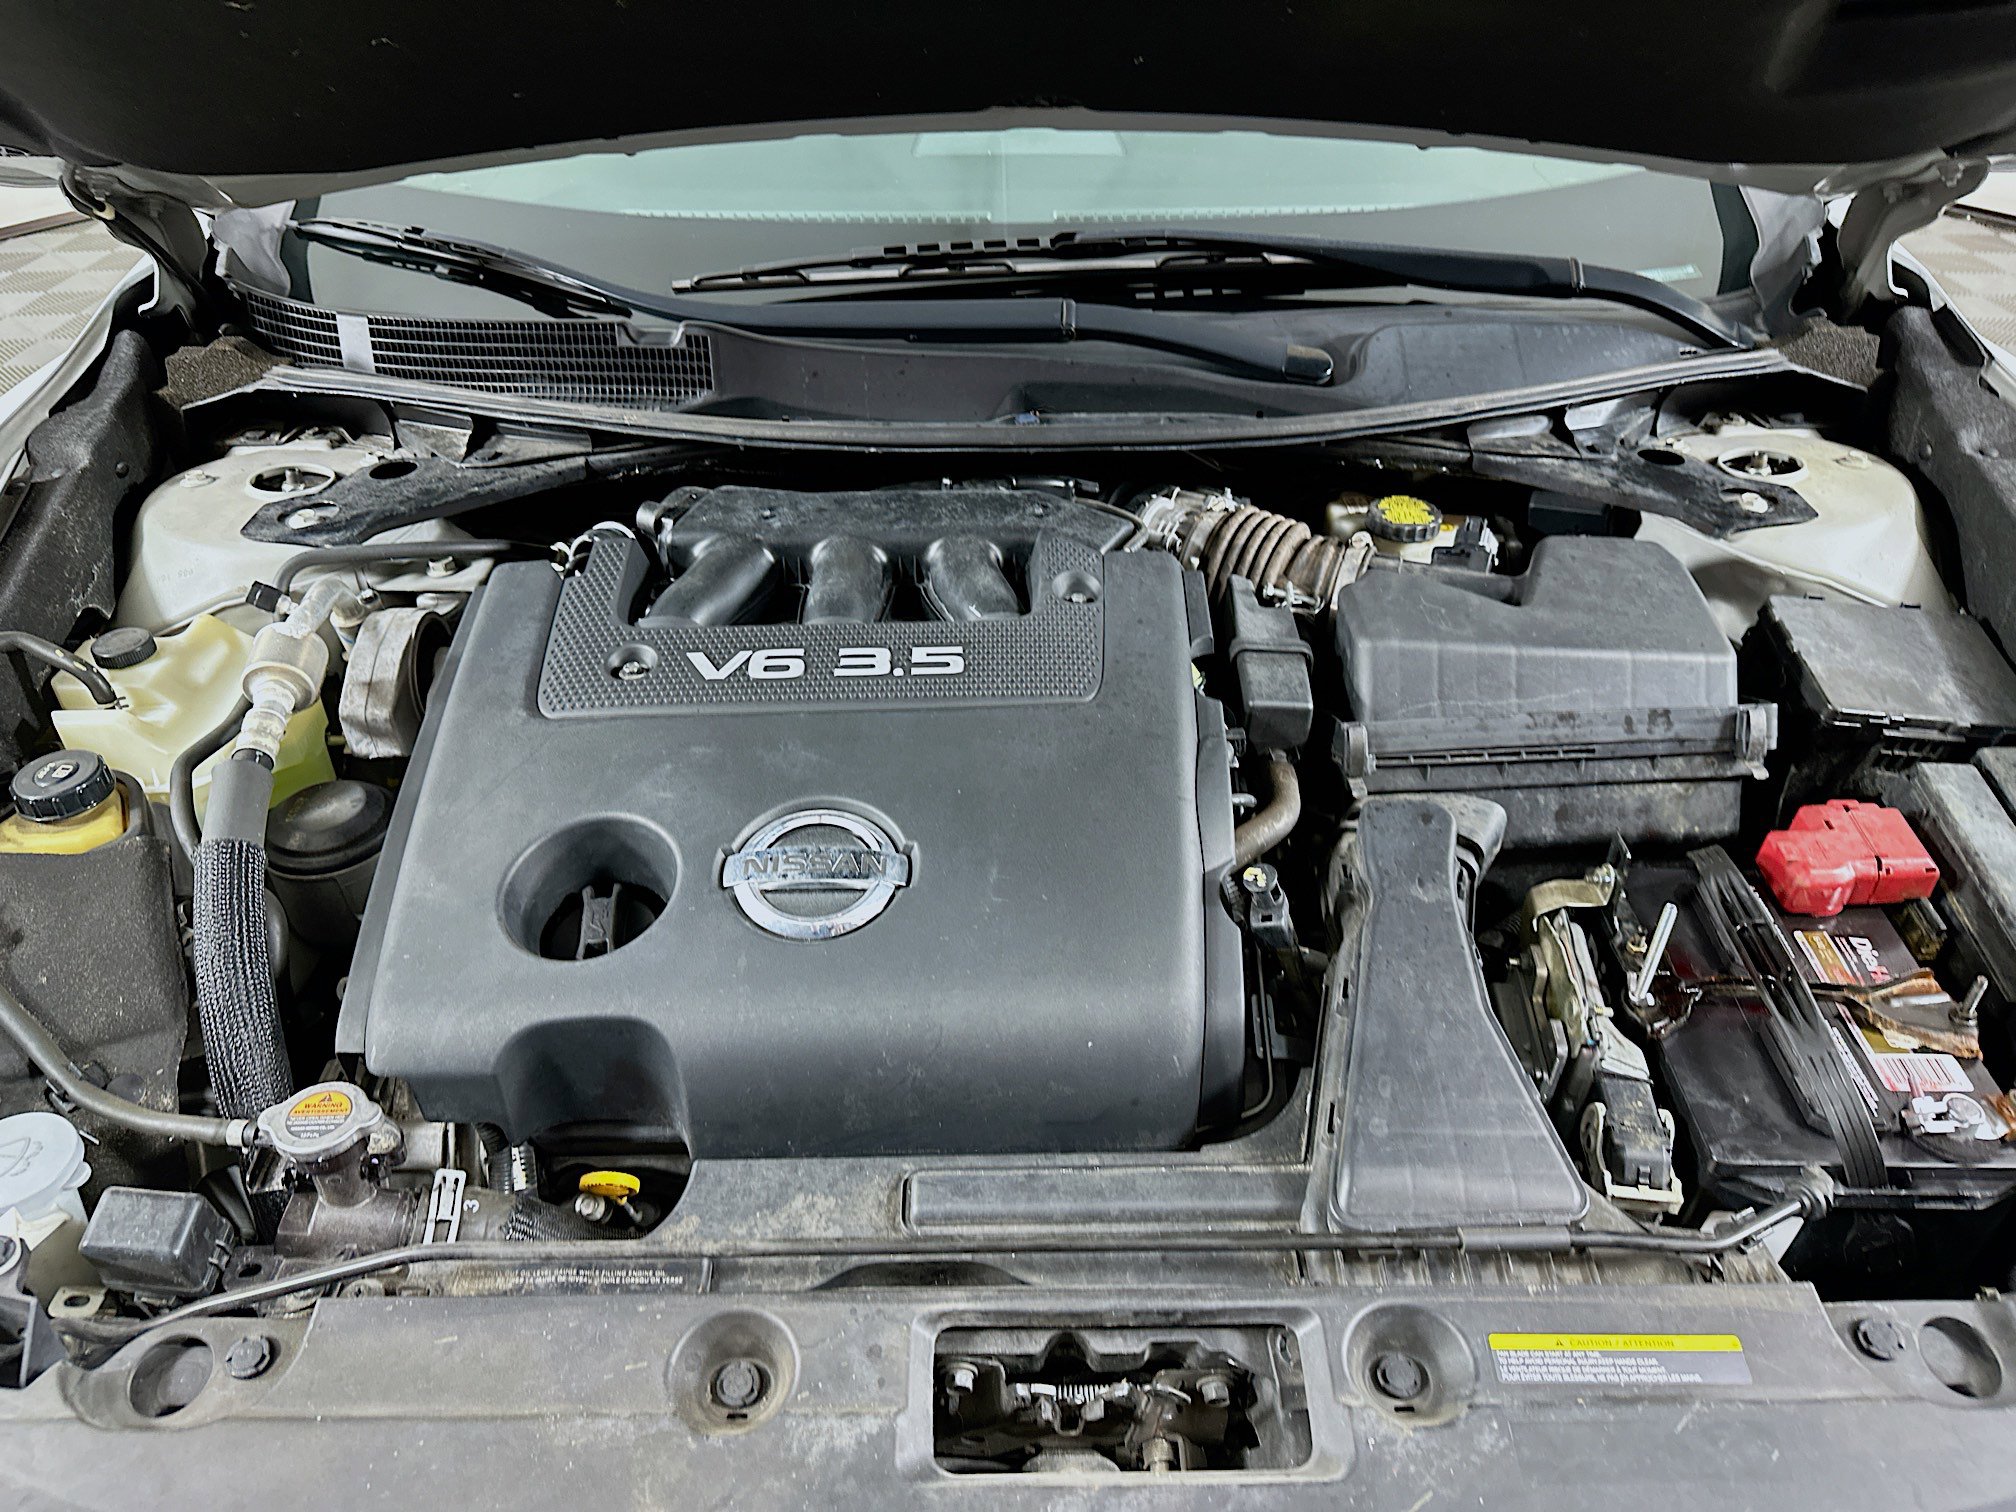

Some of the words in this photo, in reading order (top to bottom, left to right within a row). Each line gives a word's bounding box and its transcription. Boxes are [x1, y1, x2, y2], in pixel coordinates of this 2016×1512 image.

[686, 648, 806, 680] V6
[834, 646, 965, 677] 3.5
[743, 852, 887, 876] NISSAN
[304, 1101, 343, 1109] WARNING
[1569, 1339, 1612, 1347] CAUTION
[1622, 1339, 1675, 1347] ATTENTION
